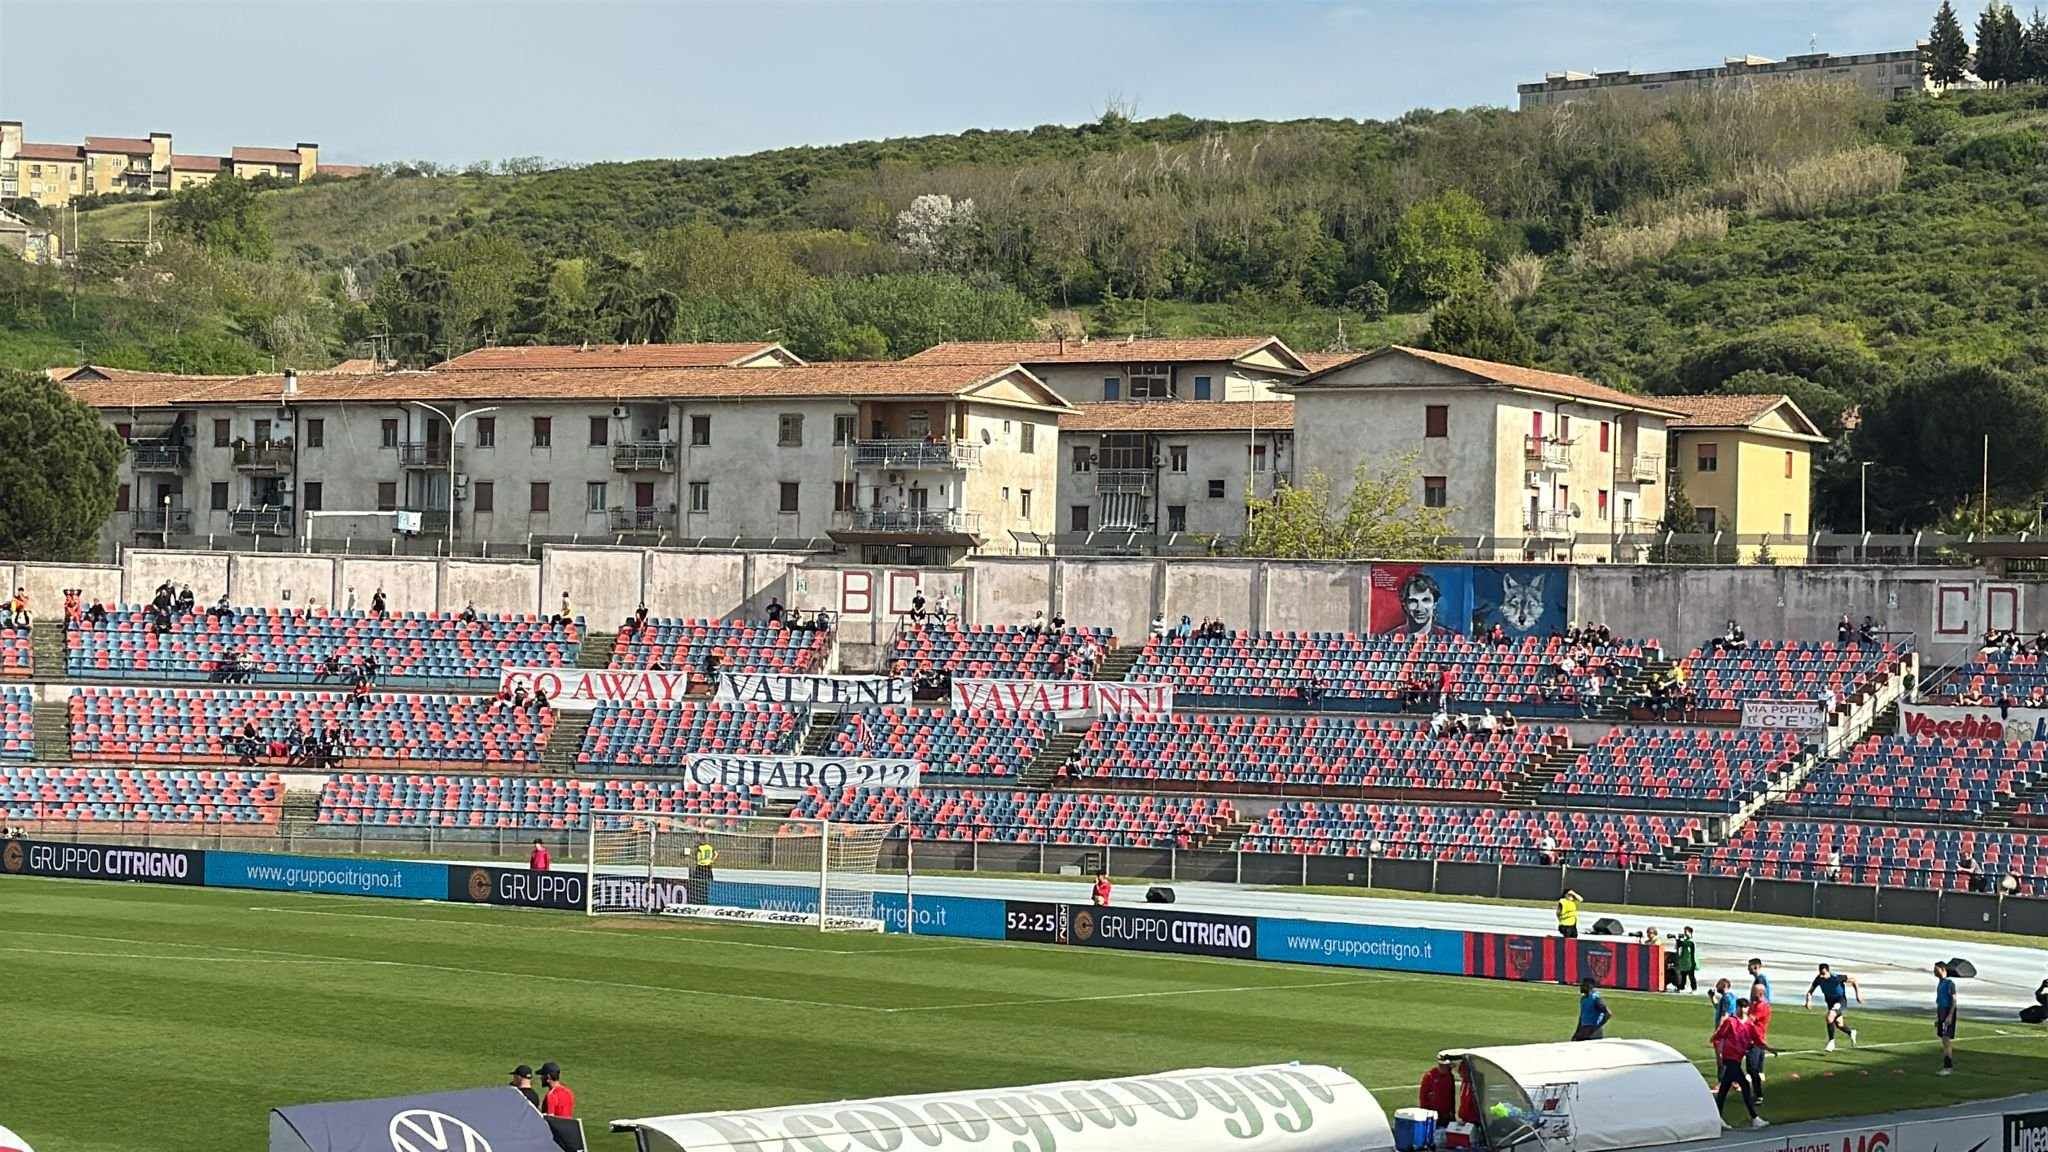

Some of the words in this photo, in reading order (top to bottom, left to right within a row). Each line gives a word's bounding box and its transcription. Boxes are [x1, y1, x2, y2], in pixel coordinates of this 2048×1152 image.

[842, 571, 872, 614] B
[1938, 587, 1969, 635] C
[572, 672, 683, 701] AWAY
[725, 675, 907, 704] VATTENE
[954, 682, 1168, 713] VAVATINNI
[1746, 705, 1767, 713] VIA
[1771, 705, 1820, 714] POPILIA
[1904, 711, 2005, 741] Vecchia
[691, 757, 847, 787] CHIARO
[857, 764, 910, 786] ?!?
[30, 845, 100, 873] GRUPPO
[105, 850, 188, 878] CITRIGNO
[247, 865, 402, 891] www.gruppocitrigno.it
[500, 873, 581, 904] GRUPPO
[1007, 911, 1055, 932] 52:25
[1101, 915, 1168, 942] GRUPPO
[1171, 920, 1251, 949] CITRIGNO
[1287, 935, 1432, 961] www.gruppocitrigno.it
